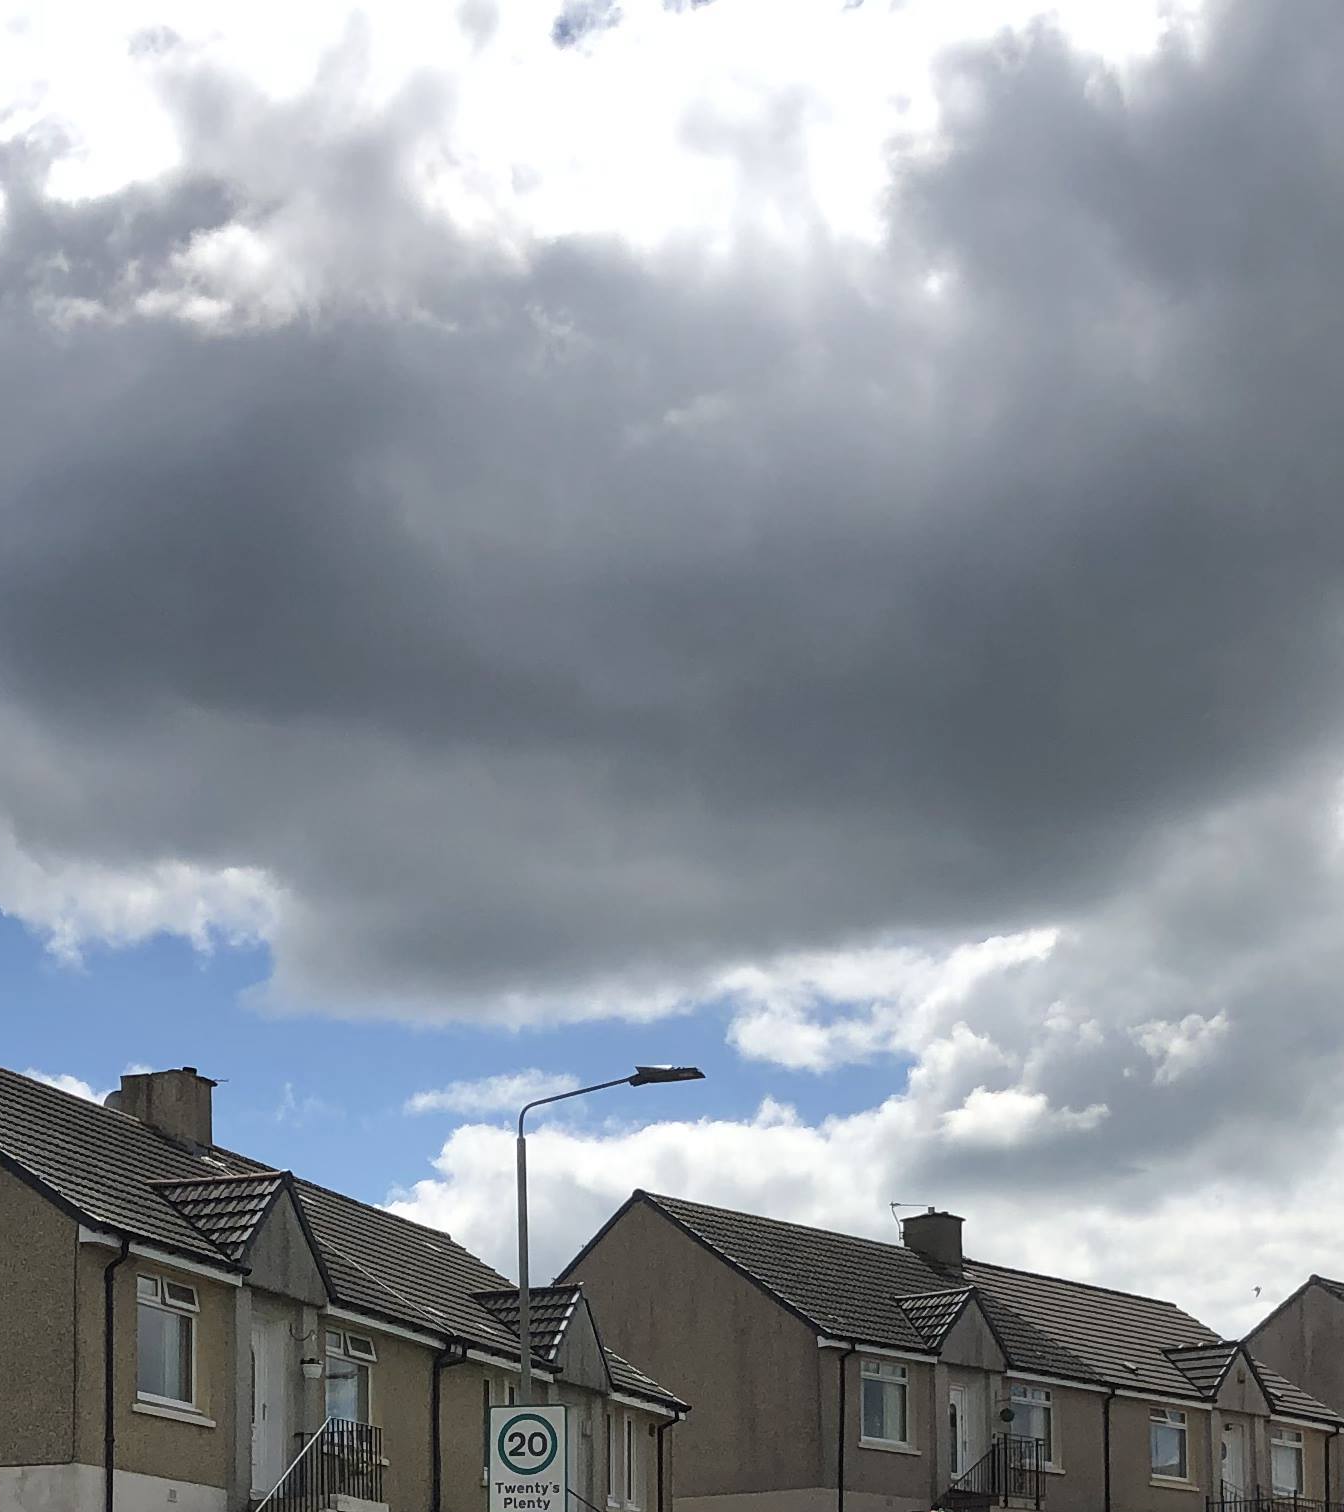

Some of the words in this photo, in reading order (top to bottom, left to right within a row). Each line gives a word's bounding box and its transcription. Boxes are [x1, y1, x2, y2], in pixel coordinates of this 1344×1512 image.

[508, 1432, 548, 1457] 20
[495, 1481, 560, 1496] Twenty's
[503, 1496, 551, 1511] Plenty
